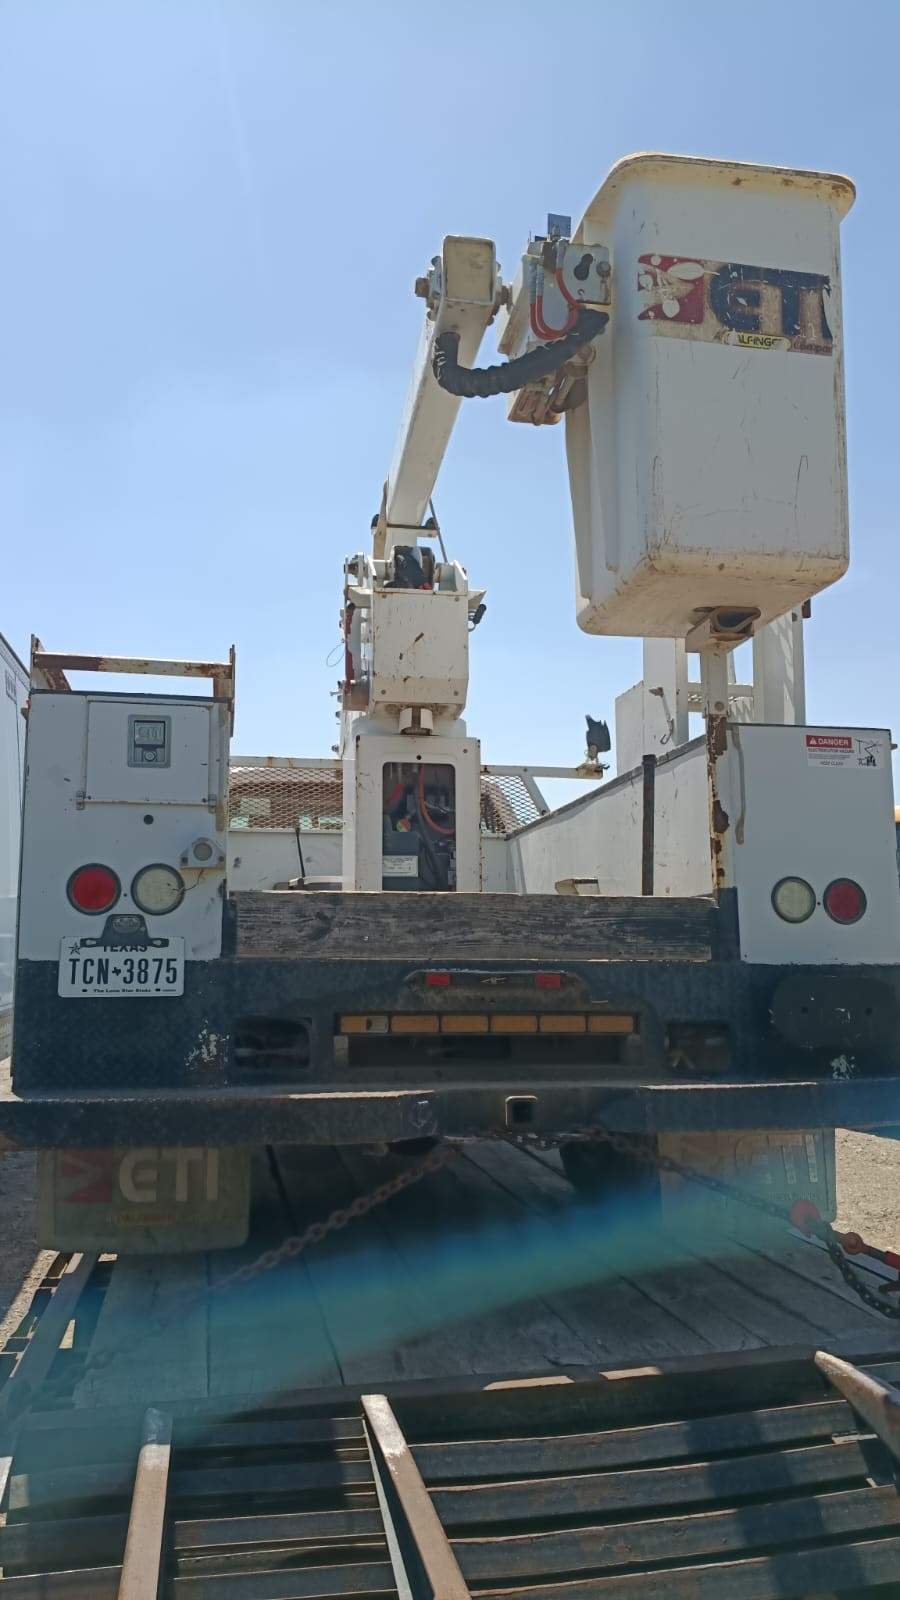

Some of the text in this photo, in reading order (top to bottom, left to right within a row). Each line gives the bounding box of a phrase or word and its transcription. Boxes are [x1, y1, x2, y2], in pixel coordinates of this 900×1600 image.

[818, 738, 848, 746] DANGER
[68, 958, 178, 985] TCN 3875
